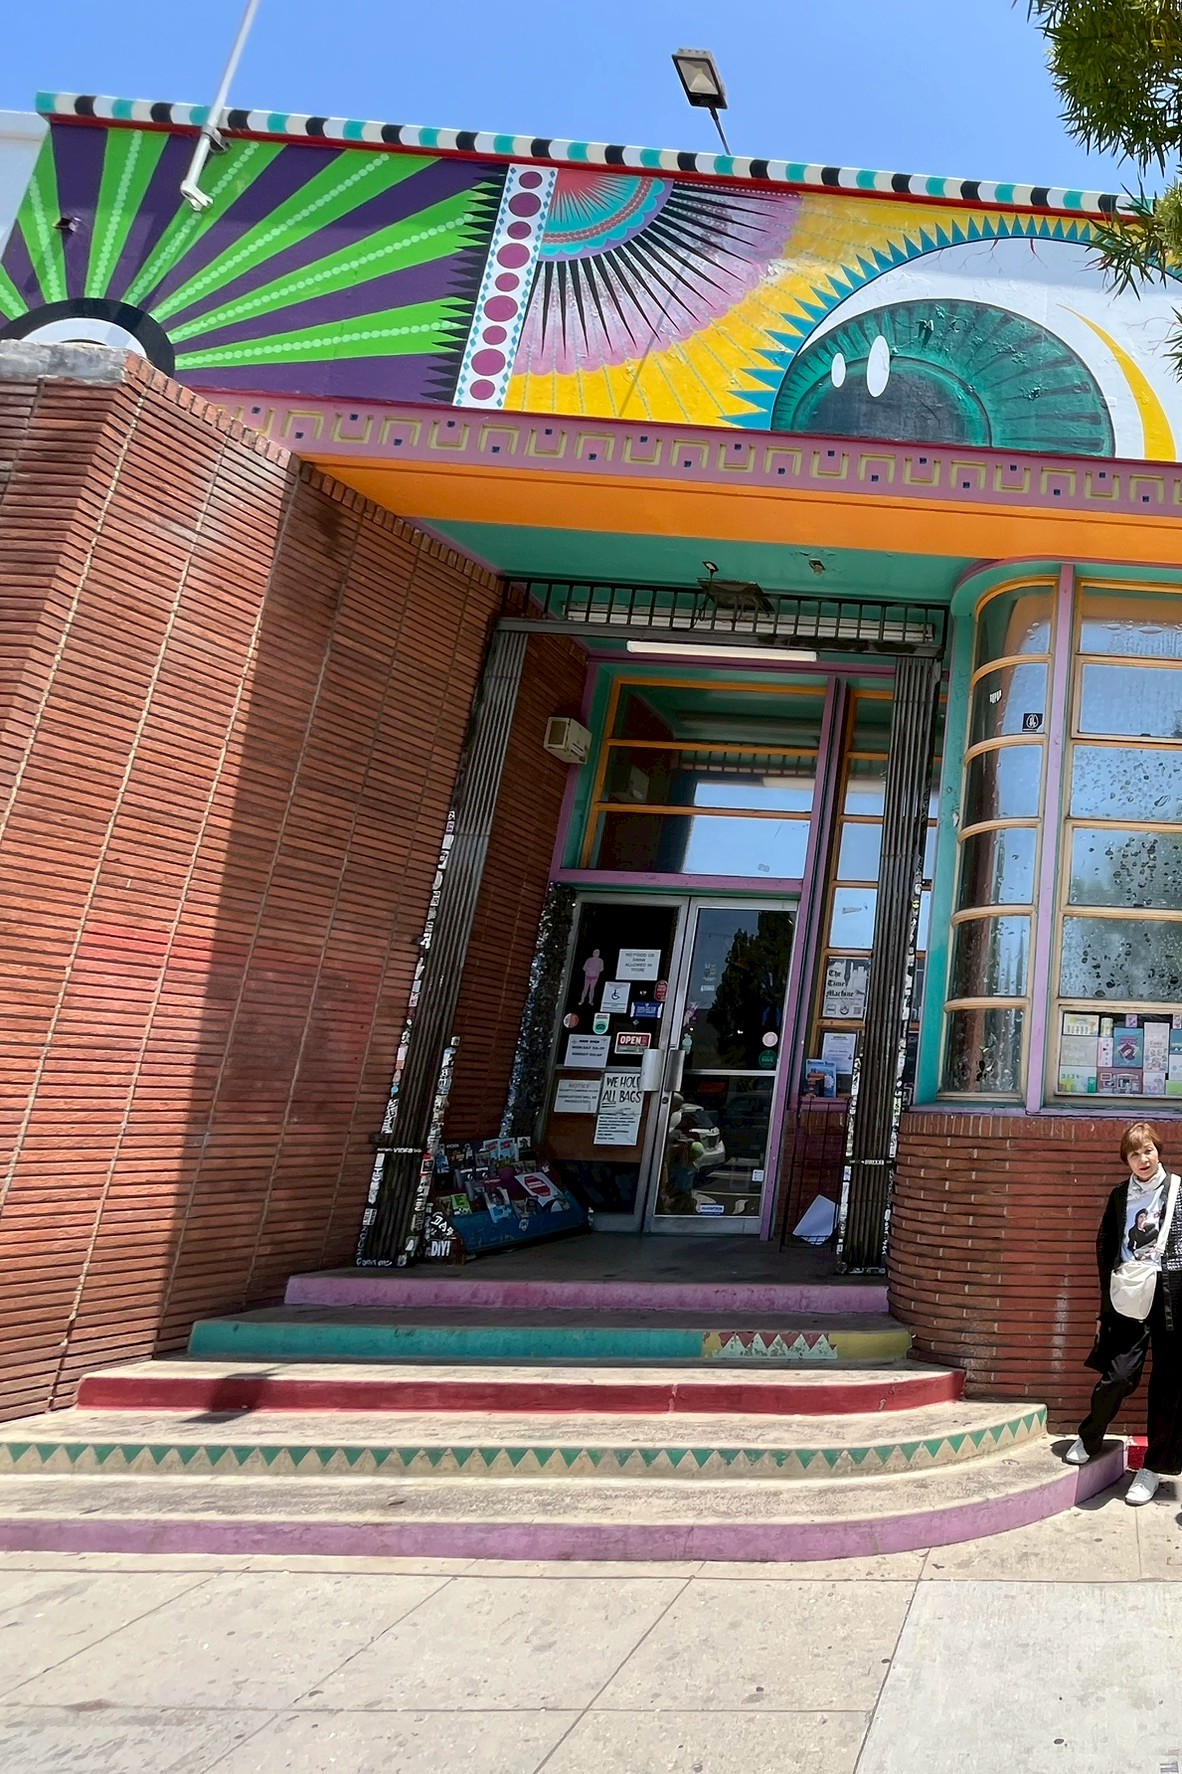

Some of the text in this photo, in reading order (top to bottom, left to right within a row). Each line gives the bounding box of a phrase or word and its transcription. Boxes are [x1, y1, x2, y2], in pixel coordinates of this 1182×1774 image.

[828, 969, 841, 977] The
[826, 989, 854, 998] Machine
[620, 1036, 642, 1044] OPEN
[606, 1076, 619, 1087] WE
[603, 1090, 642, 1103] ALL BAGS
